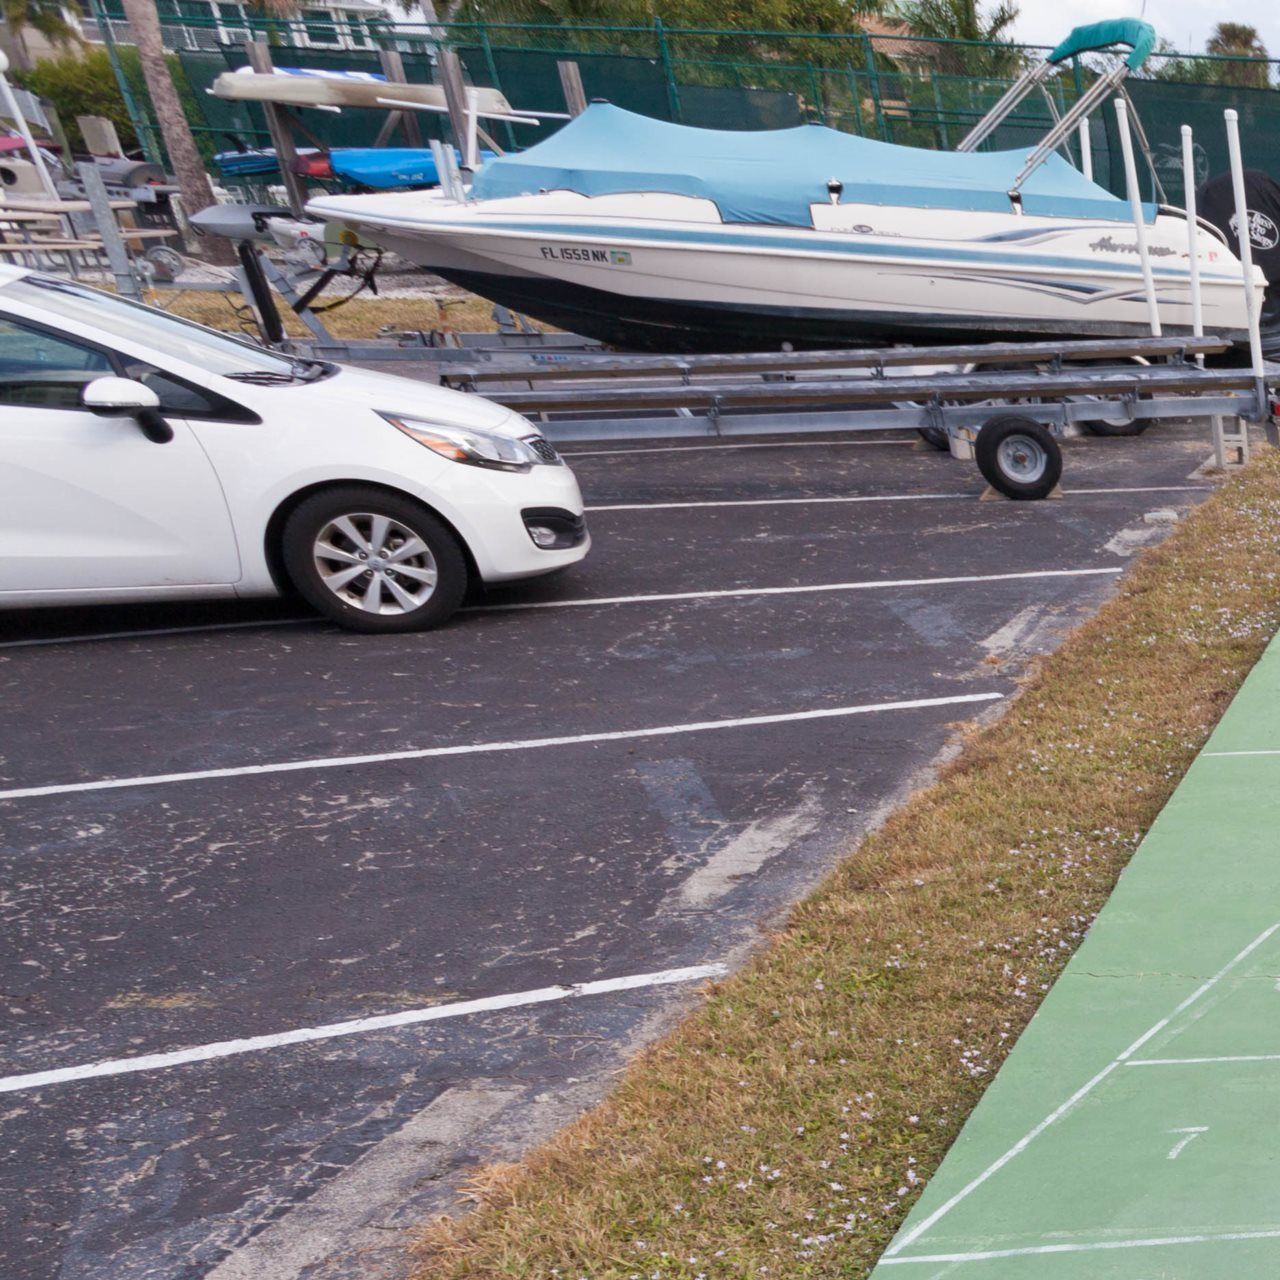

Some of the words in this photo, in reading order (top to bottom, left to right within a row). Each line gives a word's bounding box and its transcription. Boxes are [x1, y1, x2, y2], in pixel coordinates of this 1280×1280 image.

[540, 247, 558, 259] FL
[560, 248, 590, 261] 1559
[592, 250, 609, 263] NK
[1166, 1126, 1209, 1160] 7
